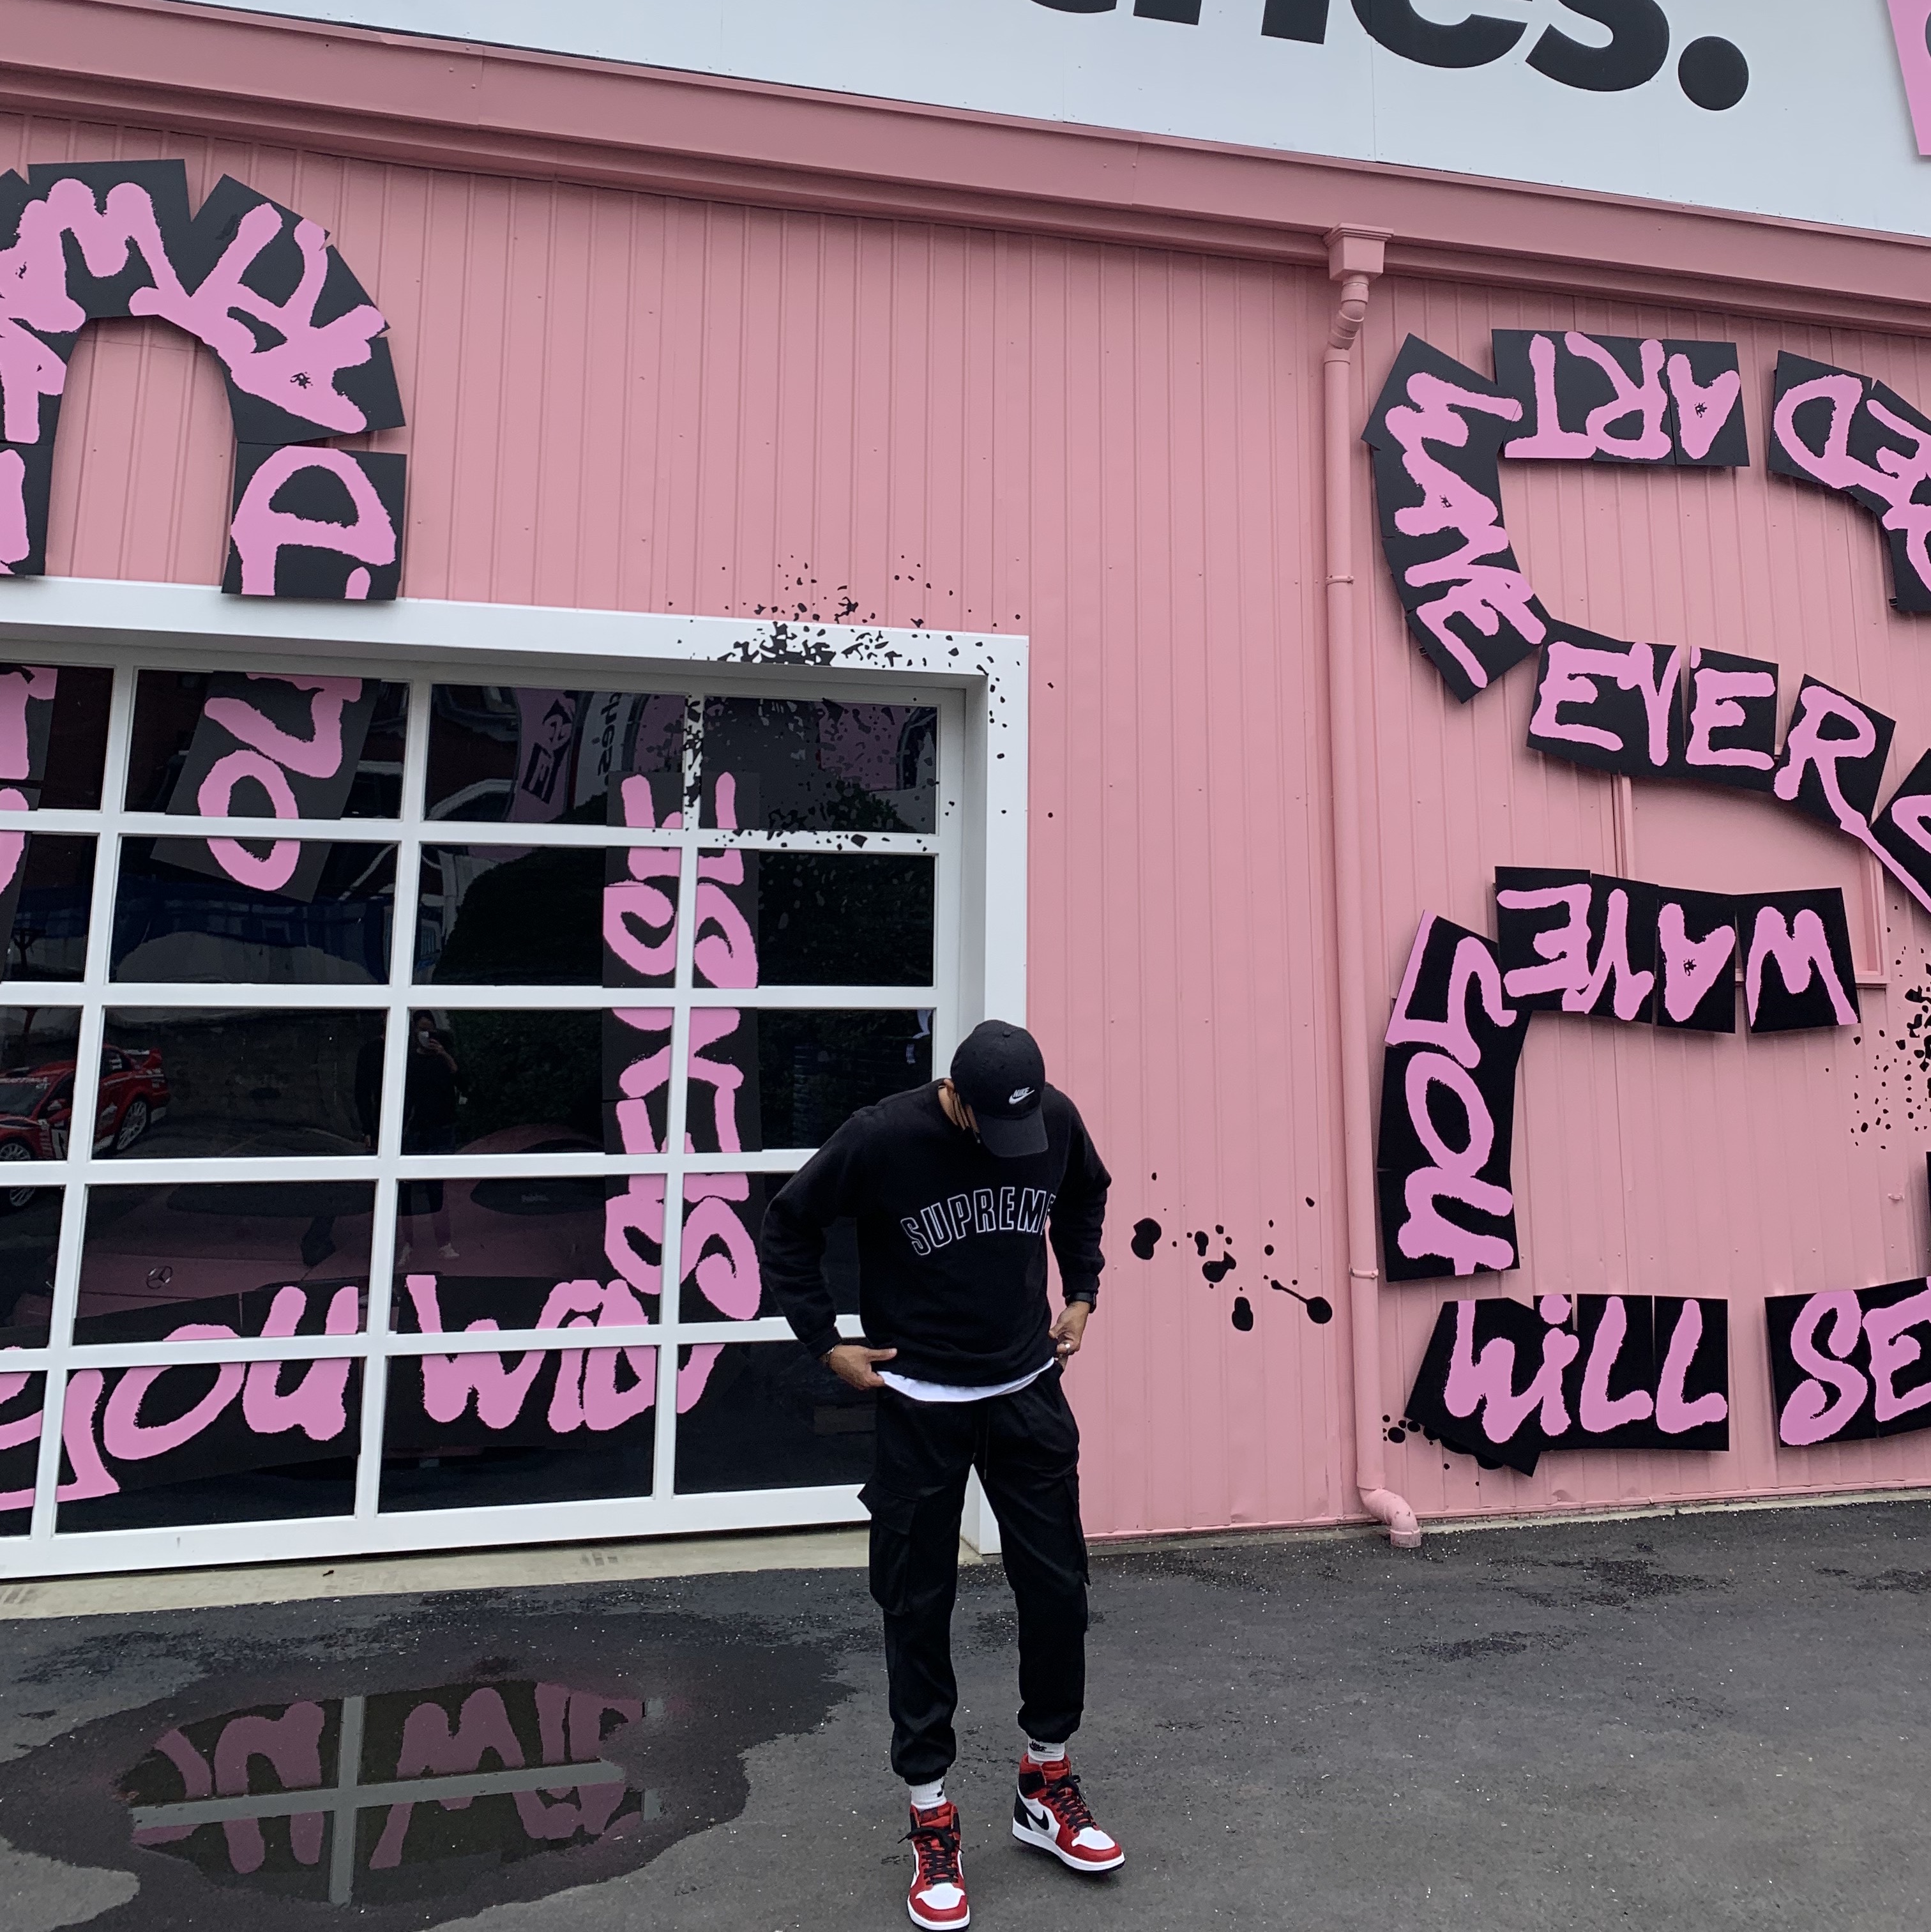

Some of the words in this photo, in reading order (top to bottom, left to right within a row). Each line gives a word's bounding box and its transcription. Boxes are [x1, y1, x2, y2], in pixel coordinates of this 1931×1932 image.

[1504, 331, 1741, 460] ART
[1529, 642, 1877, 835] EVER
[1496, 883, 1859, 1026] WAVE
[900, 1187, 1056, 1256] SUPREM
